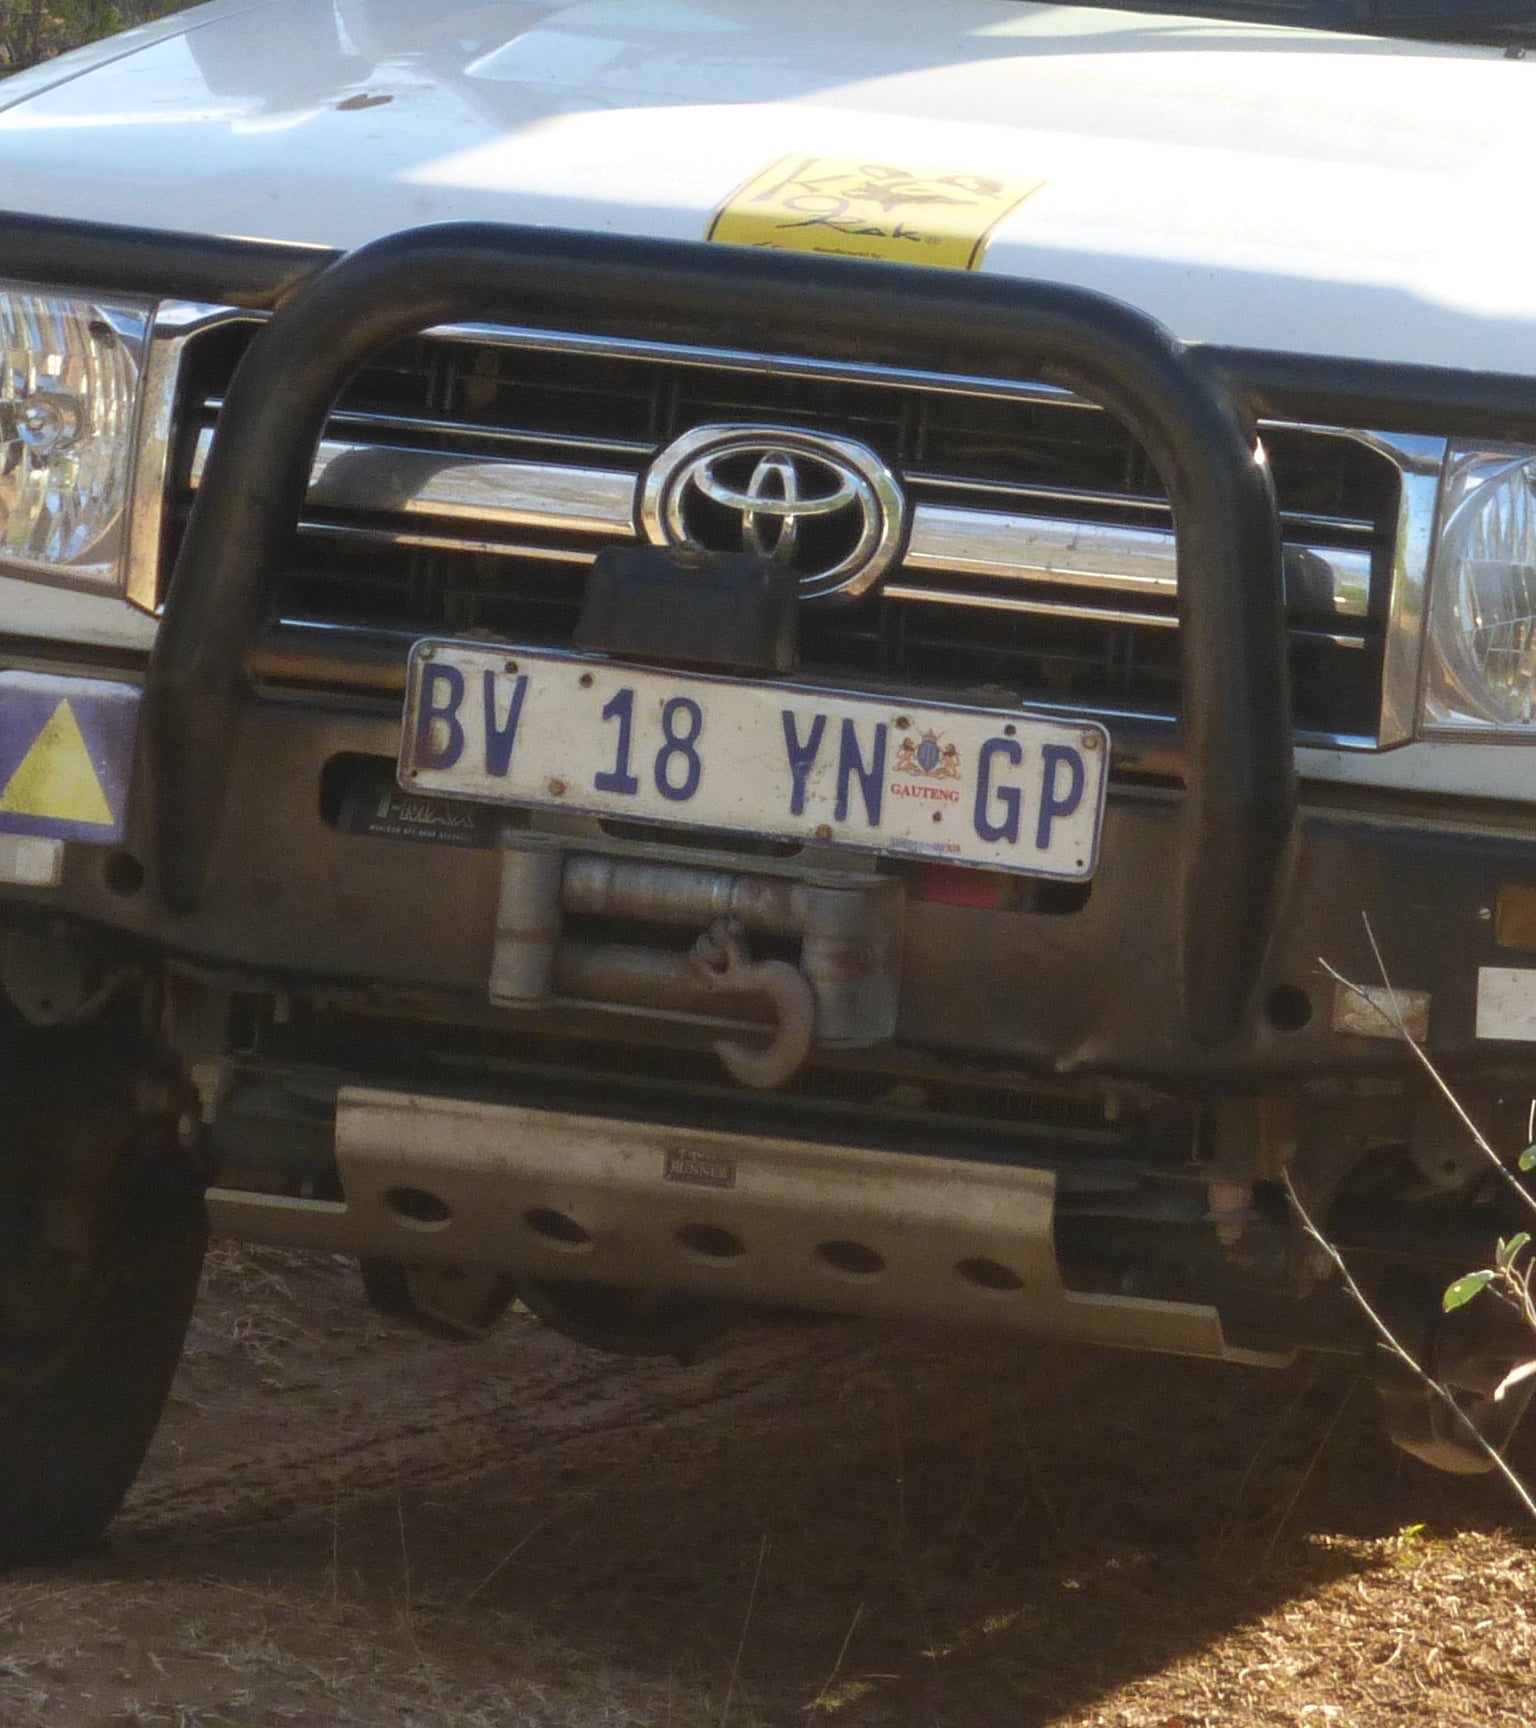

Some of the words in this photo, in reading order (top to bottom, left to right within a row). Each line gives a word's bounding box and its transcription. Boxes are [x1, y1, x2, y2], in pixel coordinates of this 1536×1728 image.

[417, 663, 529, 777] BV
[594, 687, 703, 803] 18
[781, 708, 888, 828] YN
[972, 736, 1086, 851] GP
[890, 783, 960, 803] GAUTENG
